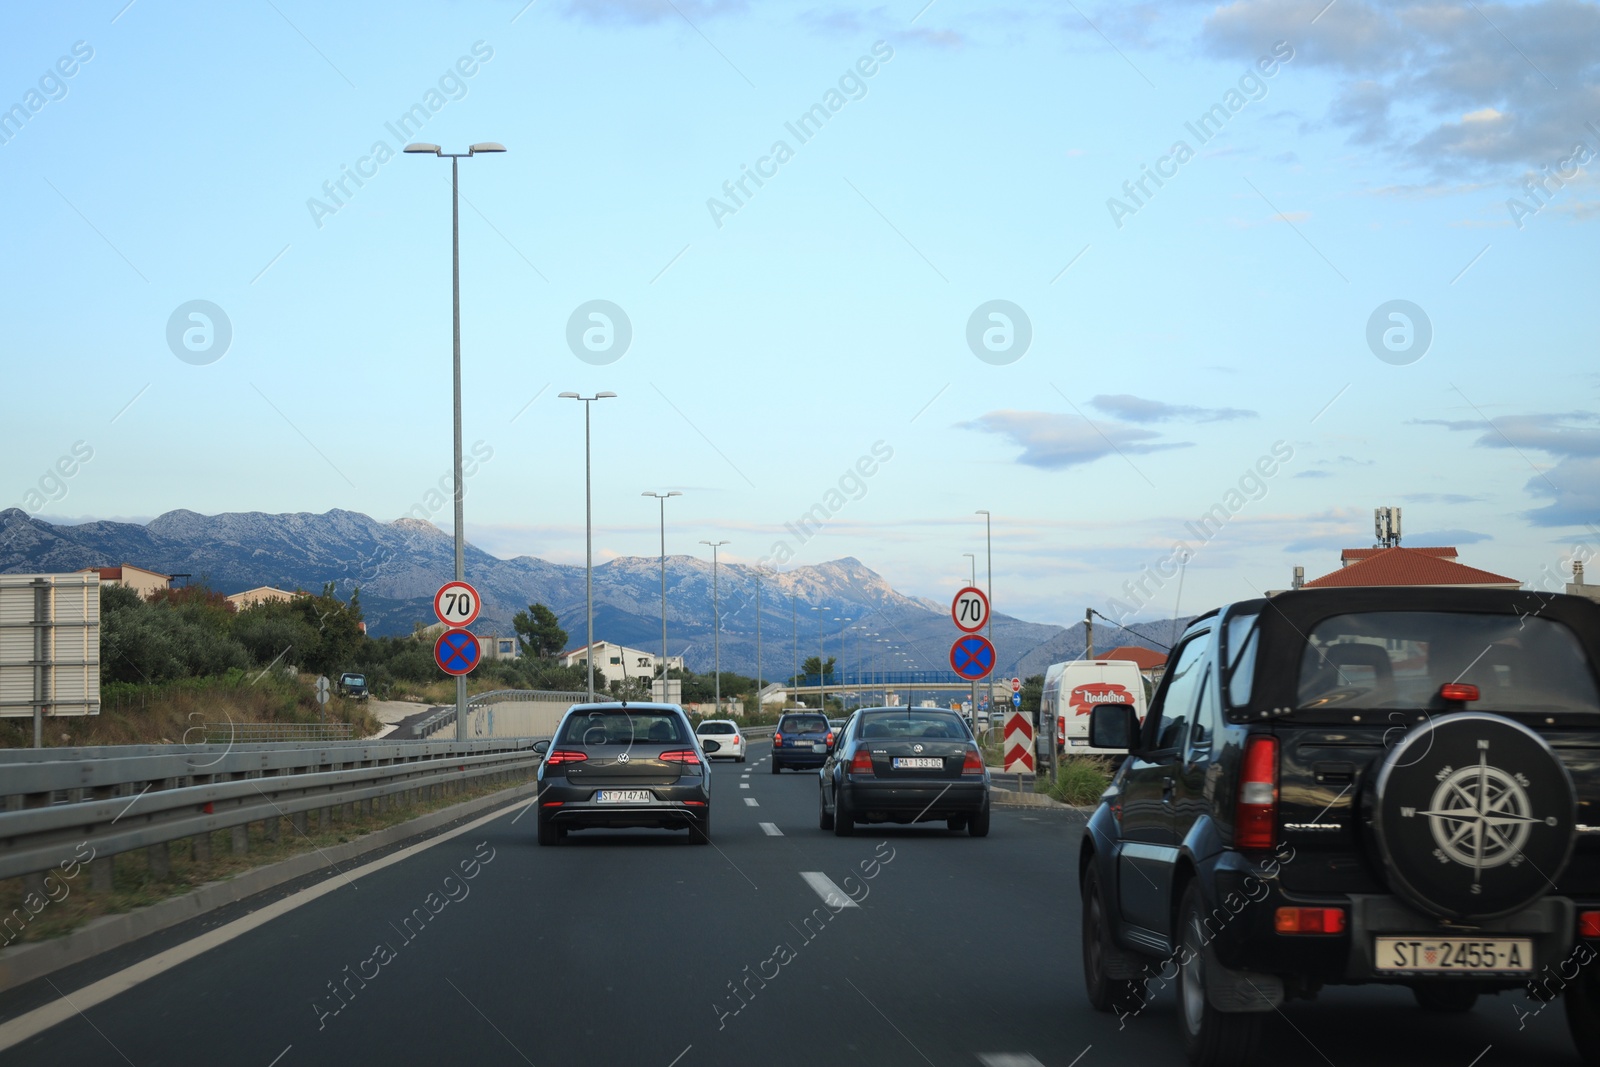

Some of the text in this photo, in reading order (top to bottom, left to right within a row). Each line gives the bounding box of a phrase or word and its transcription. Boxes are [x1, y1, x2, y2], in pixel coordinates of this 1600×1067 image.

[446, 593, 470, 616] 70
[960, 598, 981, 622] 70
[1075, 690, 1126, 704] Nadalina
[1476, 739, 1490, 750] N
[602, 791, 612, 801] ST
[1400, 806, 1417, 818] W
[1470, 883, 1482, 895] S
[1393, 941, 1524, 969] ST 2455-A
